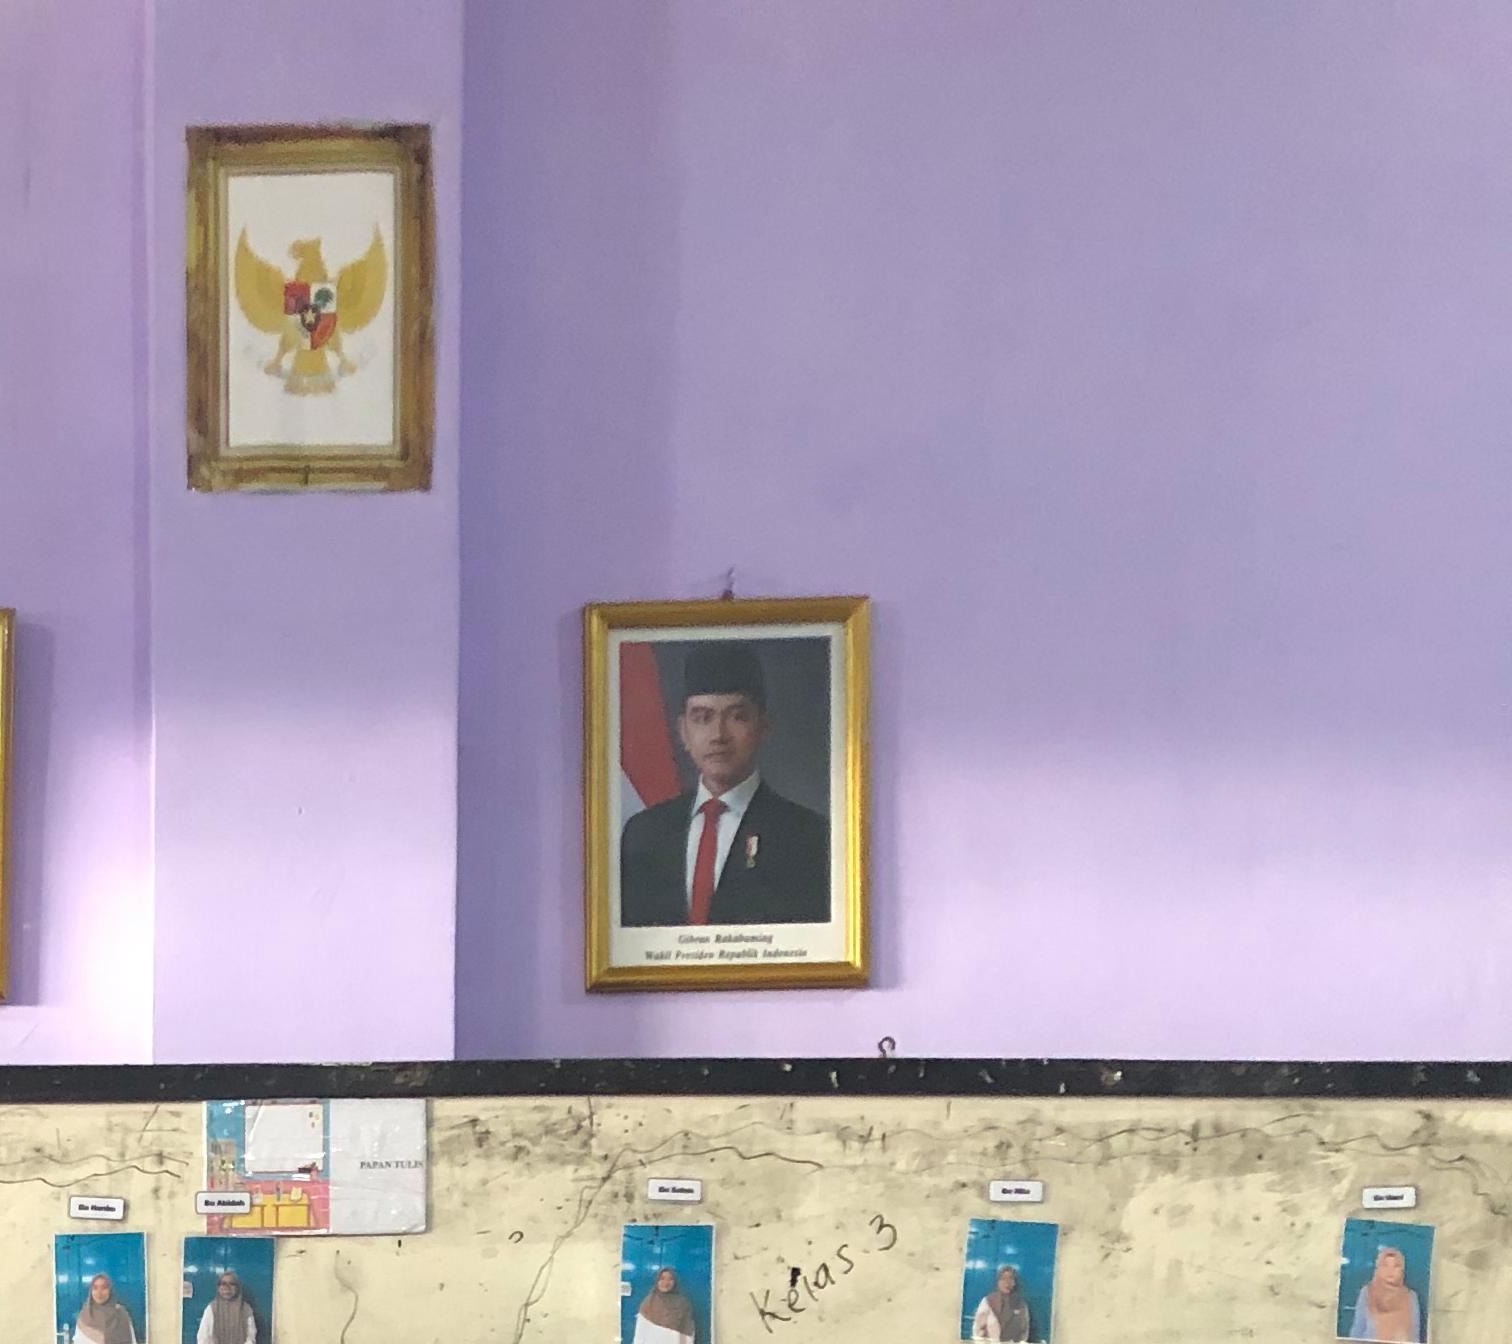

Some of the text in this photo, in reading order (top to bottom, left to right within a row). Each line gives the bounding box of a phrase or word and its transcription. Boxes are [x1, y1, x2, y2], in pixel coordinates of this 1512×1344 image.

[360, 1160, 424, 1169] PAPAN TULIS
[750, 1214, 897, 1333] Kelas 3
